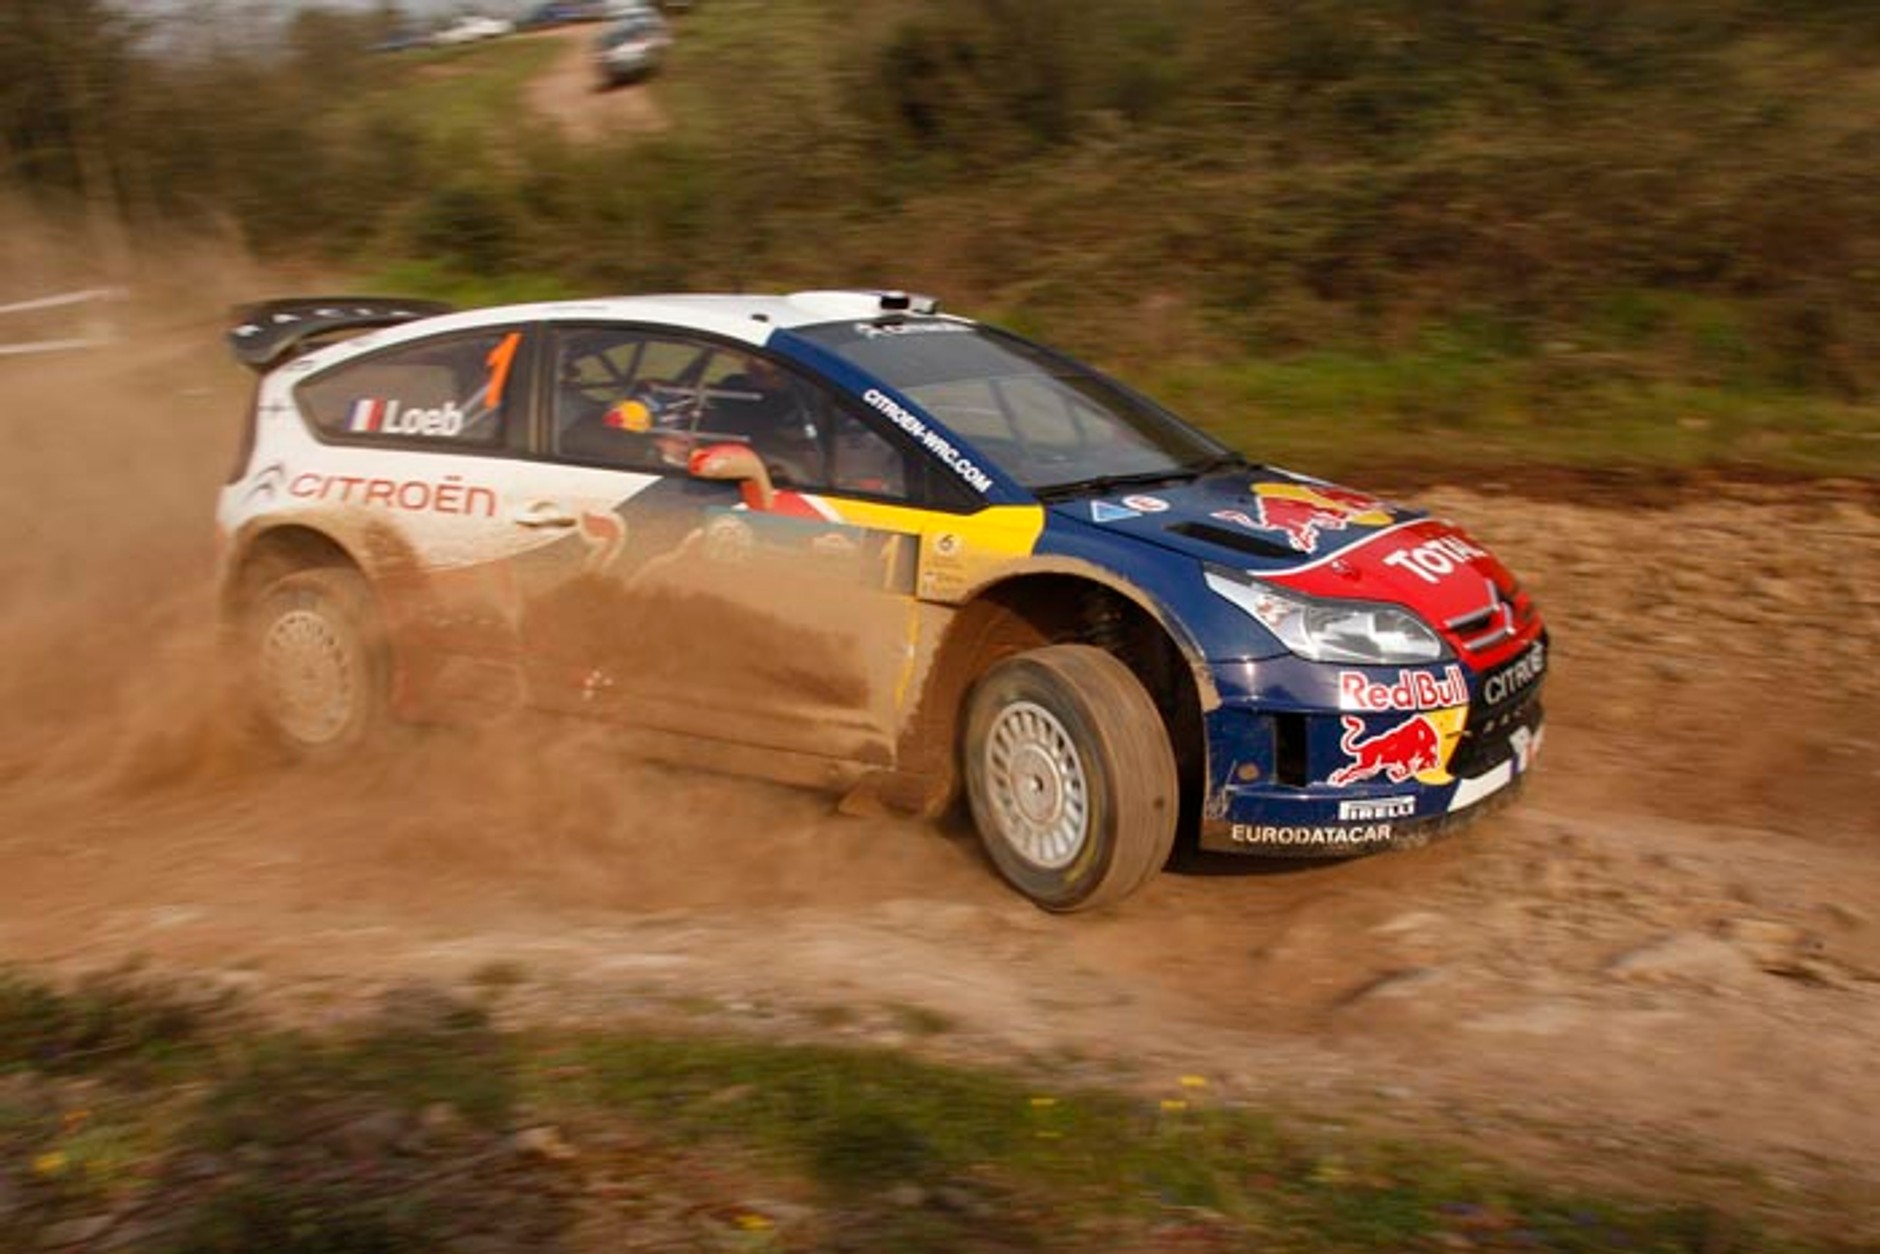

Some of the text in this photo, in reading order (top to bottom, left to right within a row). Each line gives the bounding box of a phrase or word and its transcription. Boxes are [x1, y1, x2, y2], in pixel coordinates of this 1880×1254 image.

[485, 332, 522, 409] 1
[382, 399, 464, 437] Loeb
[1341, 665, 1468, 710] Red Bull
[1231, 824, 1392, 845] EURODATACAR
